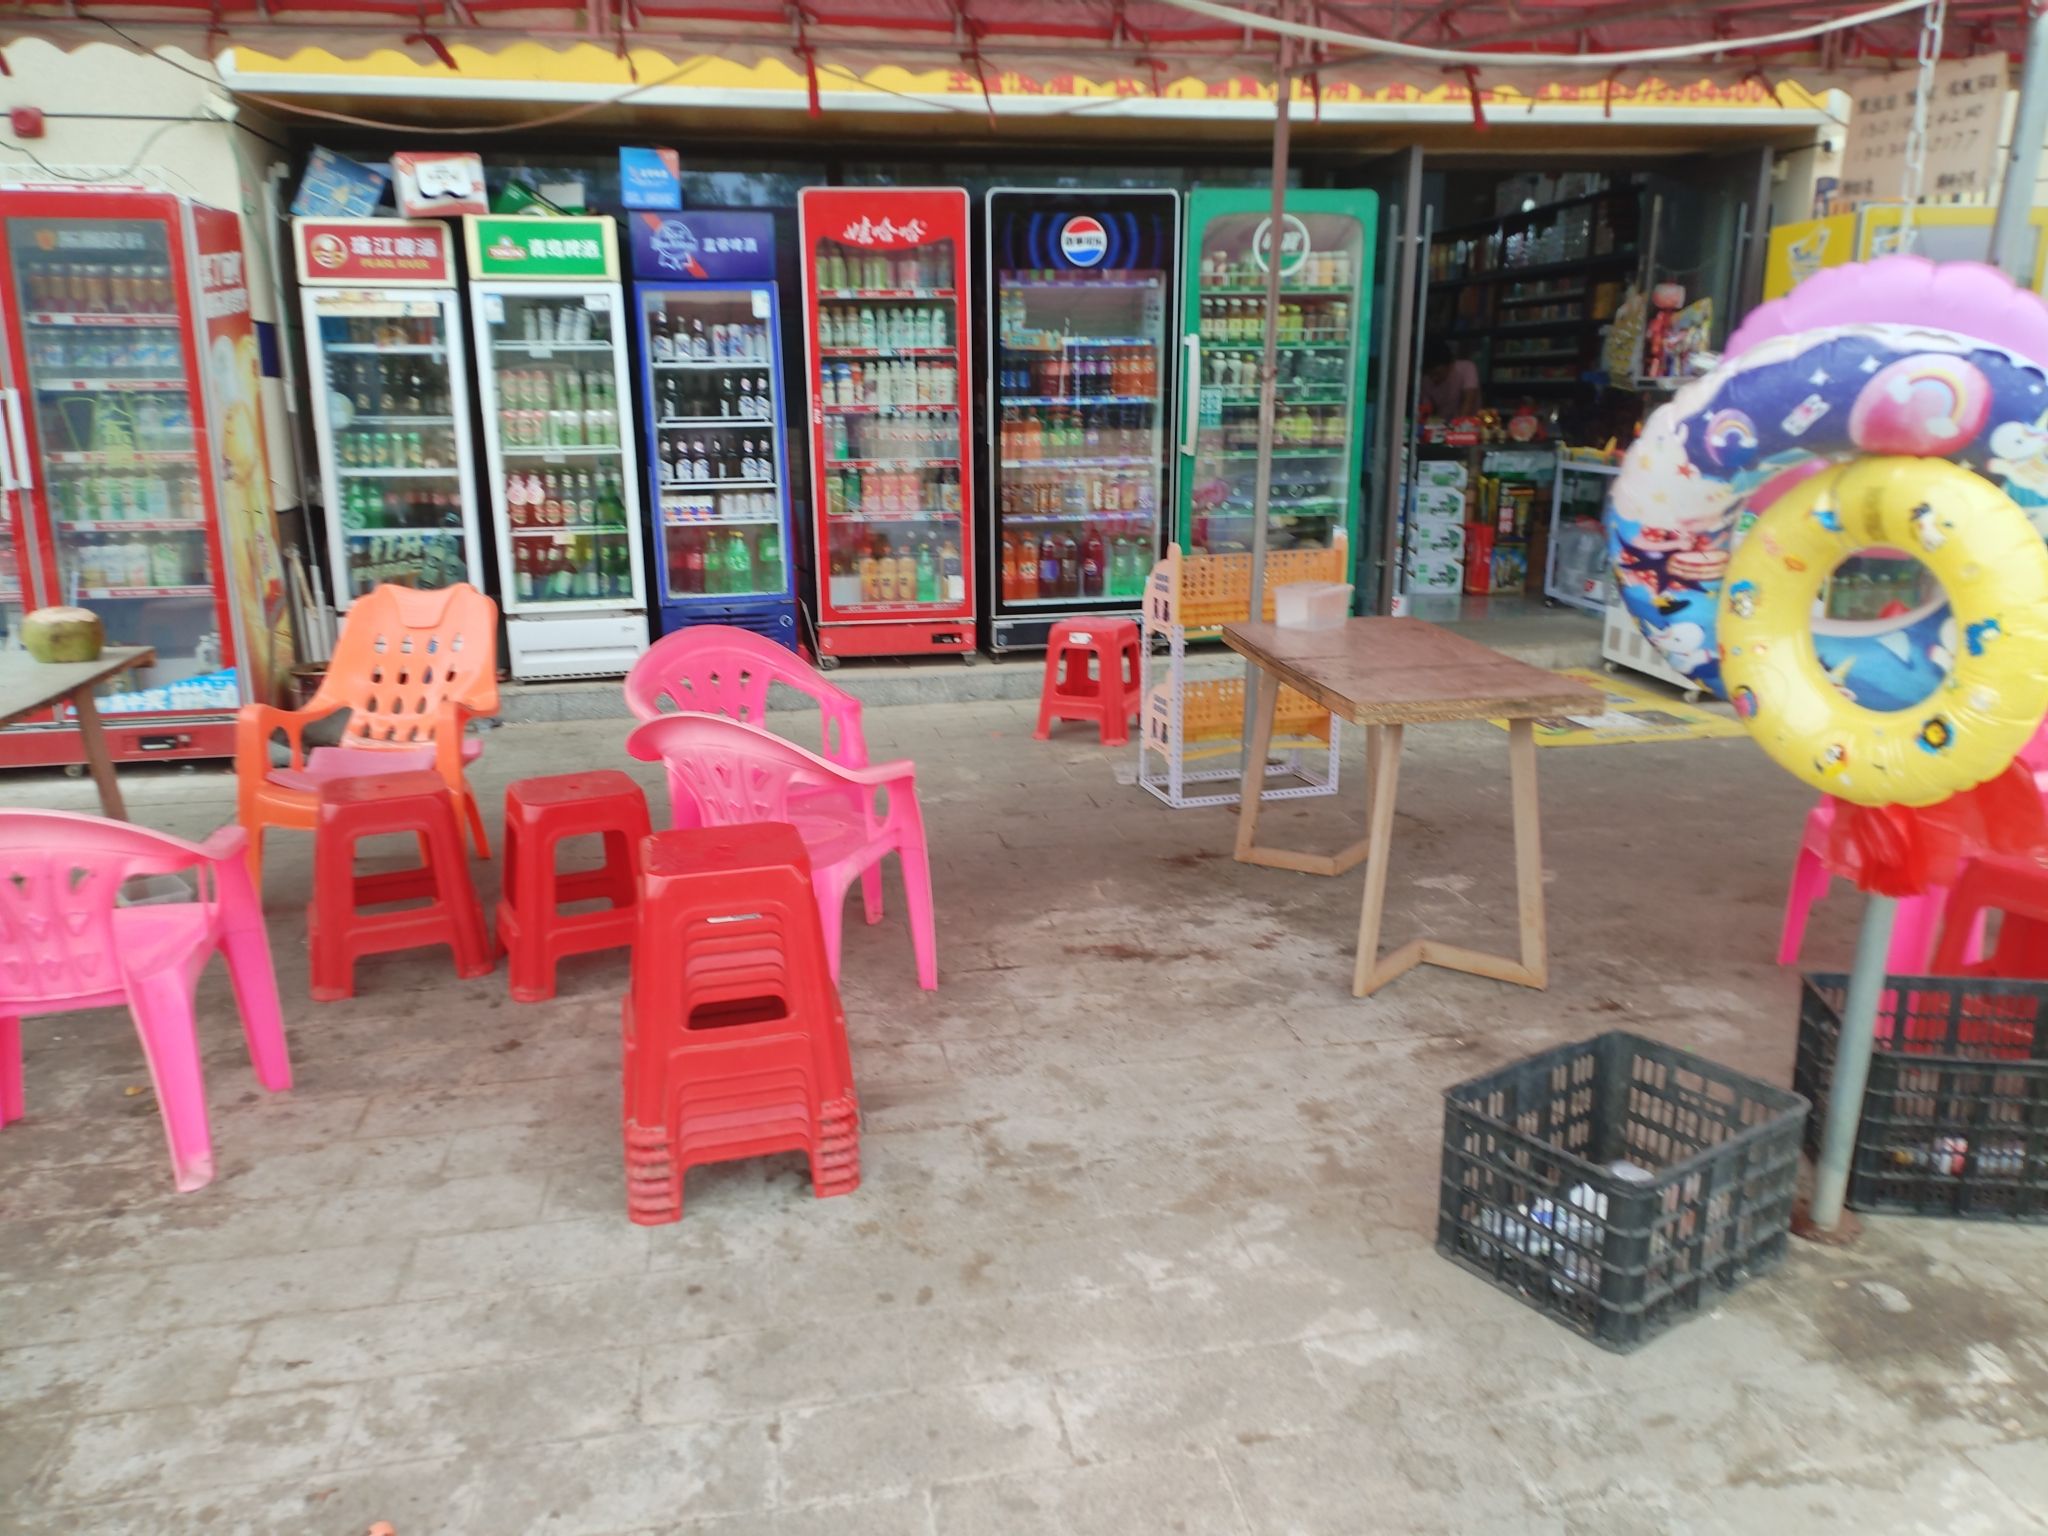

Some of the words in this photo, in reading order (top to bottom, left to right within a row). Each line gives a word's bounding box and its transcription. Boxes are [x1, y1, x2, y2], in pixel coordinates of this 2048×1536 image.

[843, 215, 927, 244] 娃哈哈
[349, 235, 438, 258] 珠江啤酒
[528, 238, 600, 259] 青岛啤酒
[702, 236, 759, 254] 蓝带啤酒
